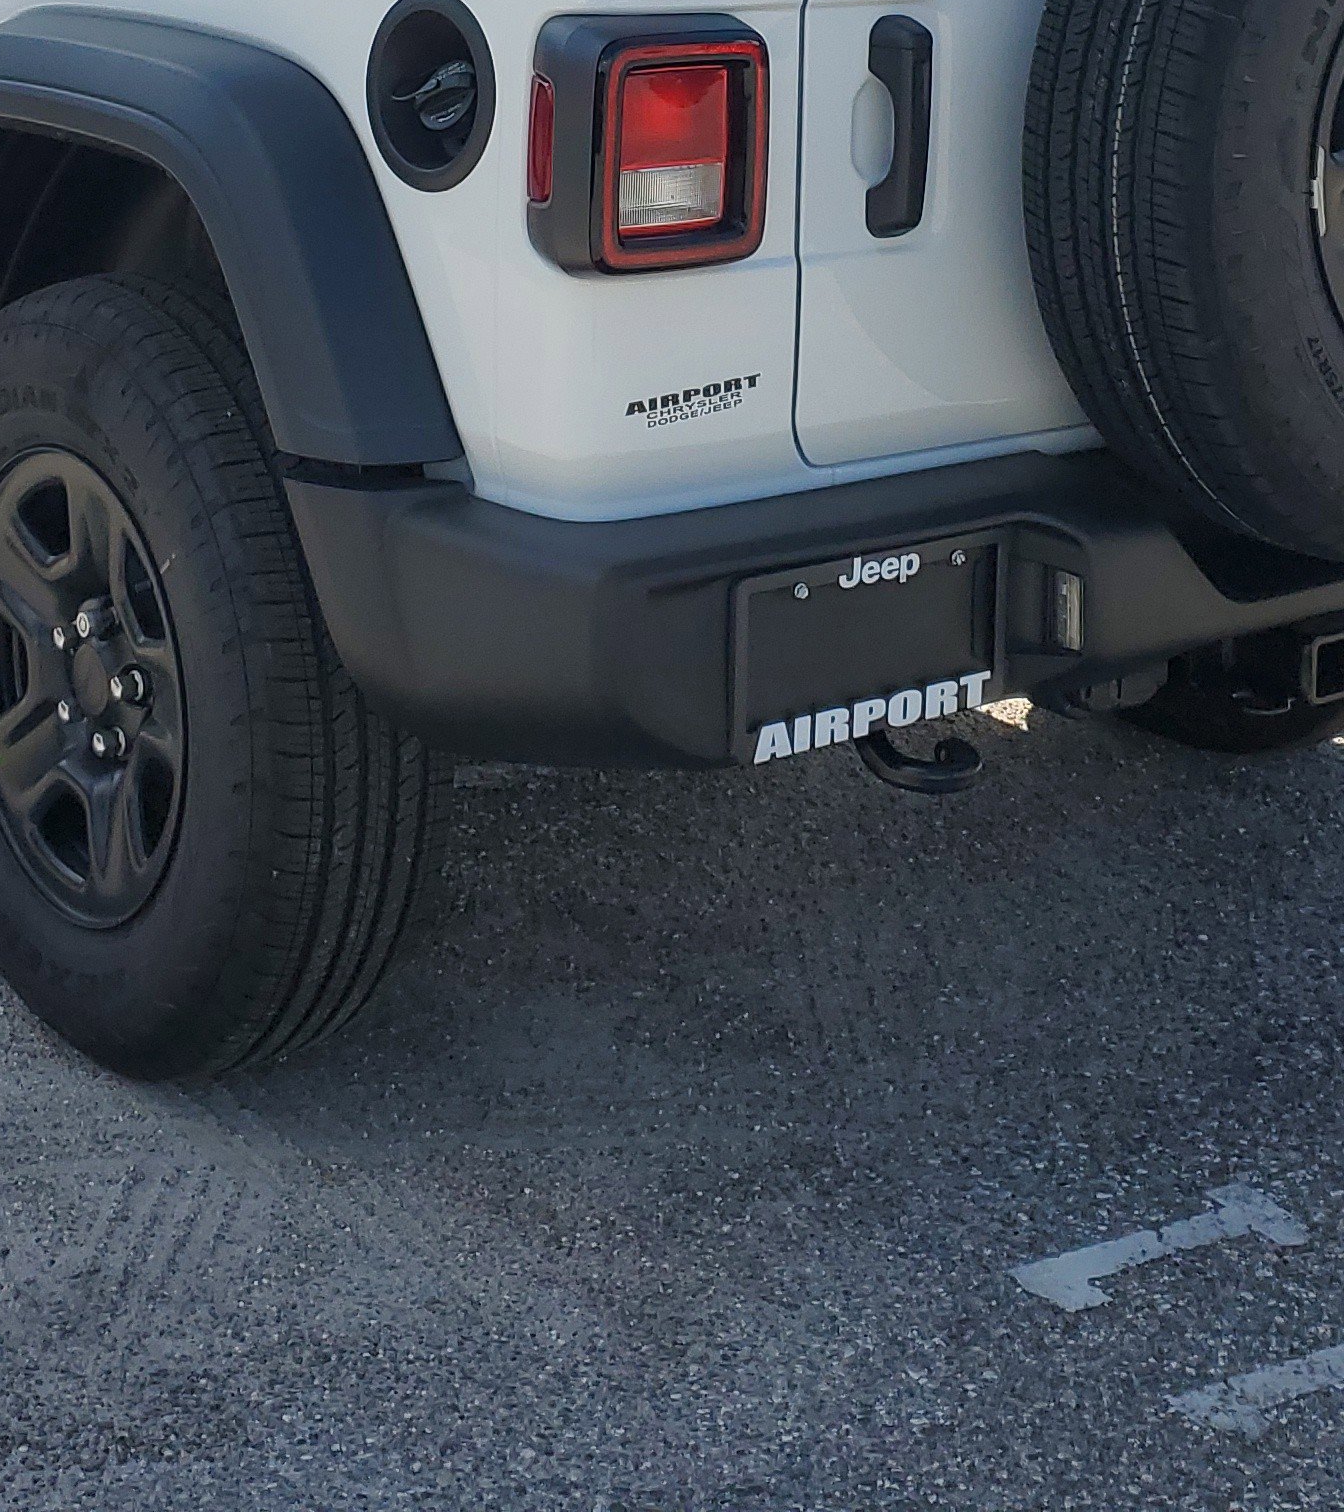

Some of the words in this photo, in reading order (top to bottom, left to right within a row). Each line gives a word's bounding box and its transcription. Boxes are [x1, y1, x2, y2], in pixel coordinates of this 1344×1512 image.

[624, 373, 762, 417] AIRPORT
[646, 390, 743, 420] CHRYSLER
[647, 398, 744, 429] DODGE/JEEP
[838, 552, 920, 589] Jeep
[752, 669, 991, 766] AIRPORT
